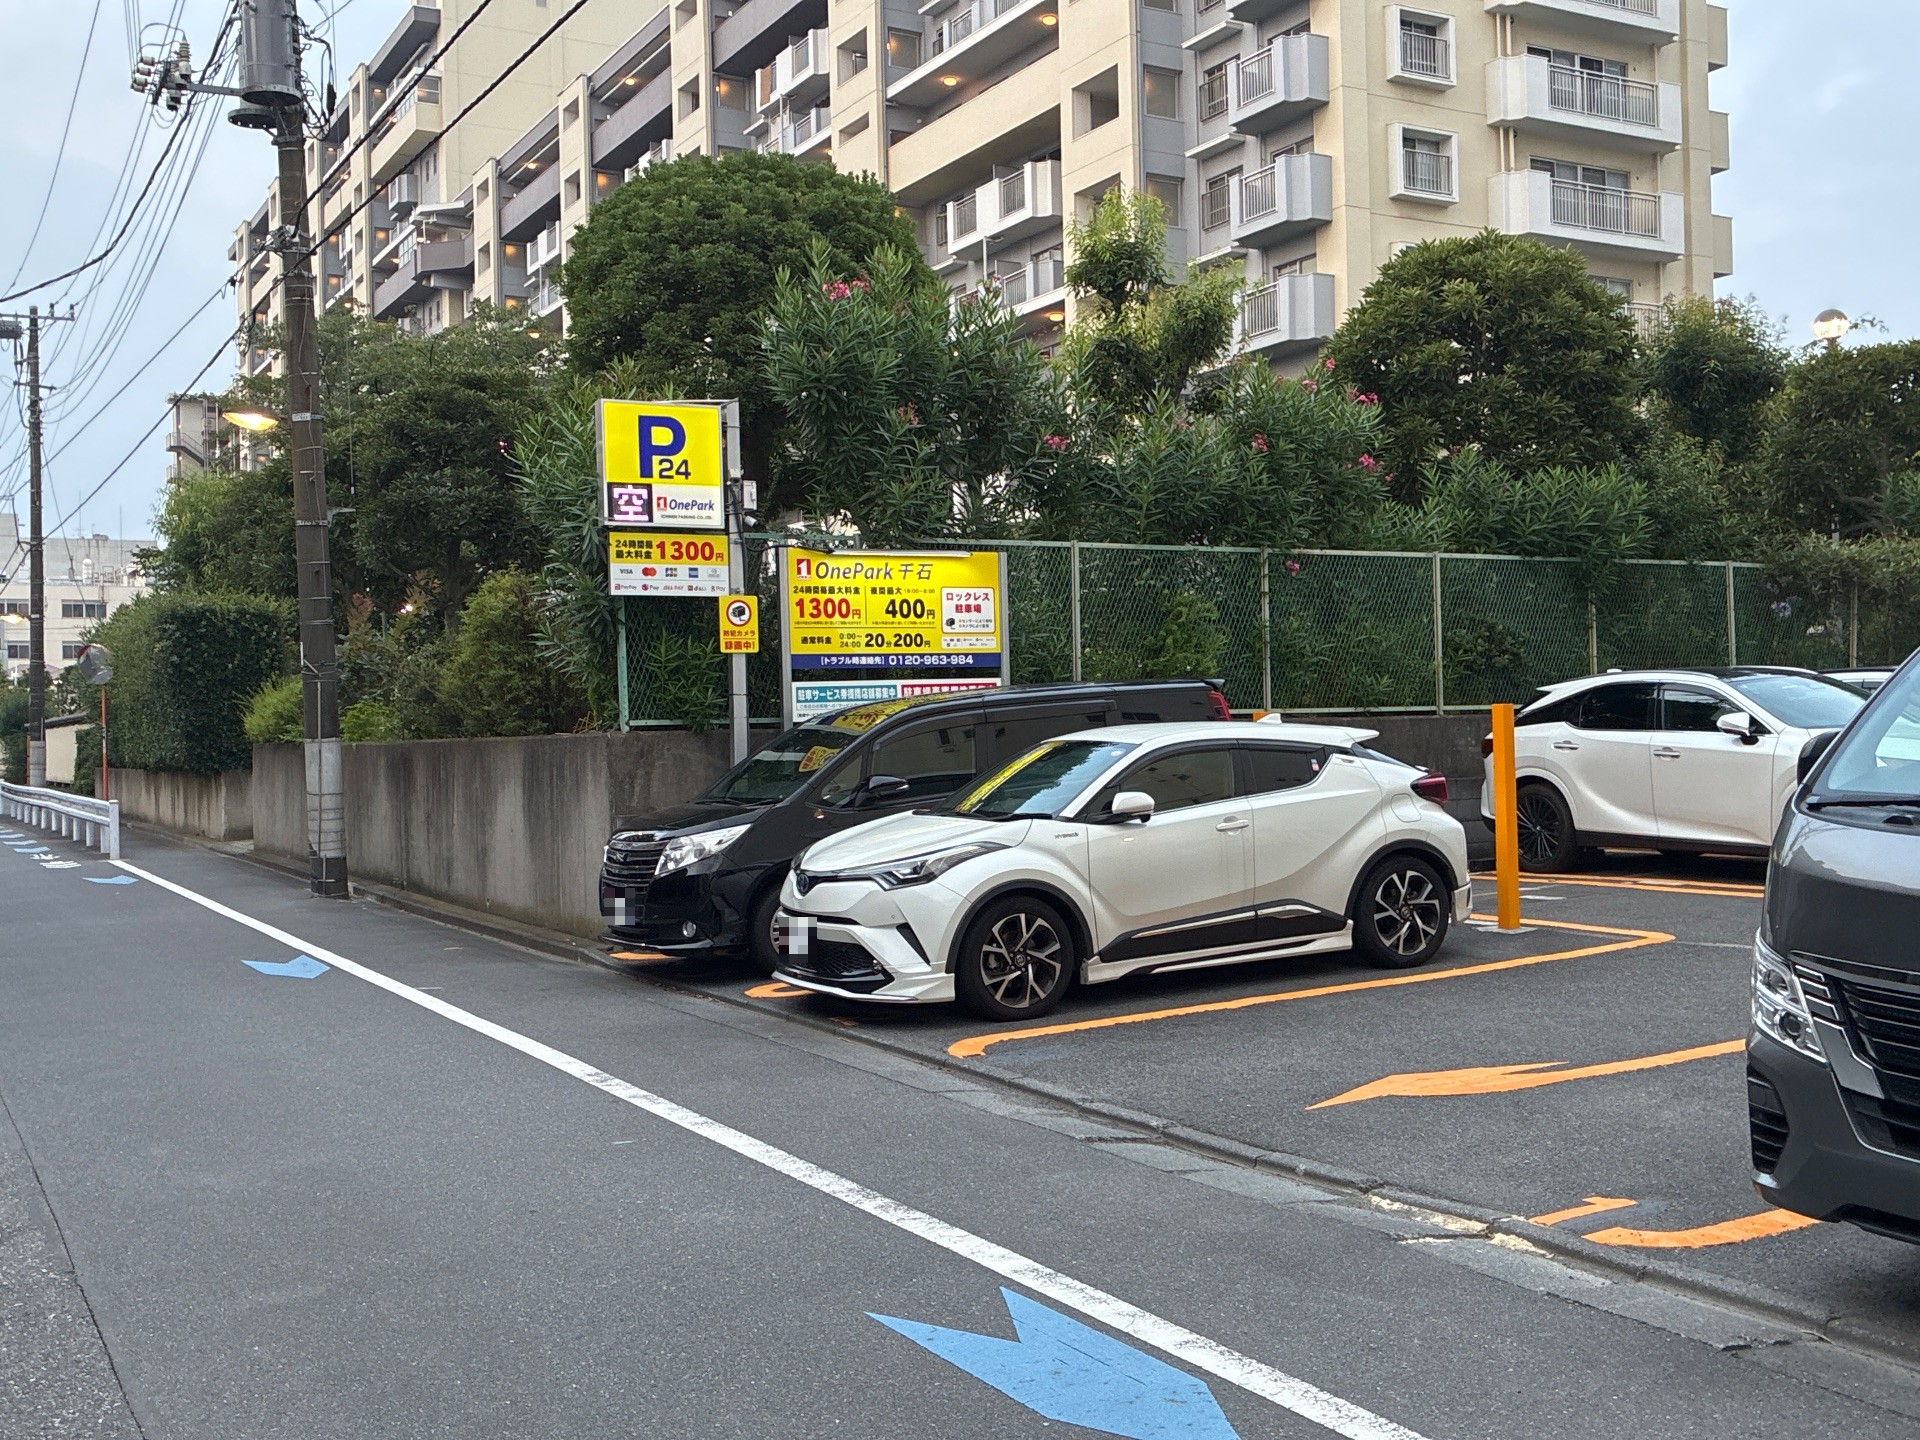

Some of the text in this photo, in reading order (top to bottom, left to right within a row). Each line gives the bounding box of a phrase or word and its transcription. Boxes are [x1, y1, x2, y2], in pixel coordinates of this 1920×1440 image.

[638, 415, 686, 478] P
[658, 458, 691, 480] 24
[613, 484, 649, 521] 空
[669, 499, 715, 511] OnePark
[615, 539, 653, 549] 24時間毎
[615, 549, 652, 559] 最大料金
[656, 540, 724, 562] 1300円
[815, 561, 894, 580] OnePark
[898, 563, 933, 580] 千石
[793, 585, 860, 595] 24時間毎最大料金
[870, 587, 902, 595] 夜間最大
[946, 592, 990, 601] ロックレス
[795, 597, 861, 619] 1300円
[885, 598, 935, 619] 400円
[955, 604, 982, 613] 駐車場
[801, 636, 832, 645] 通常料金
[864, 633, 931, 648] 20分200円
[888, 655, 974, 665] 0120-963-984
